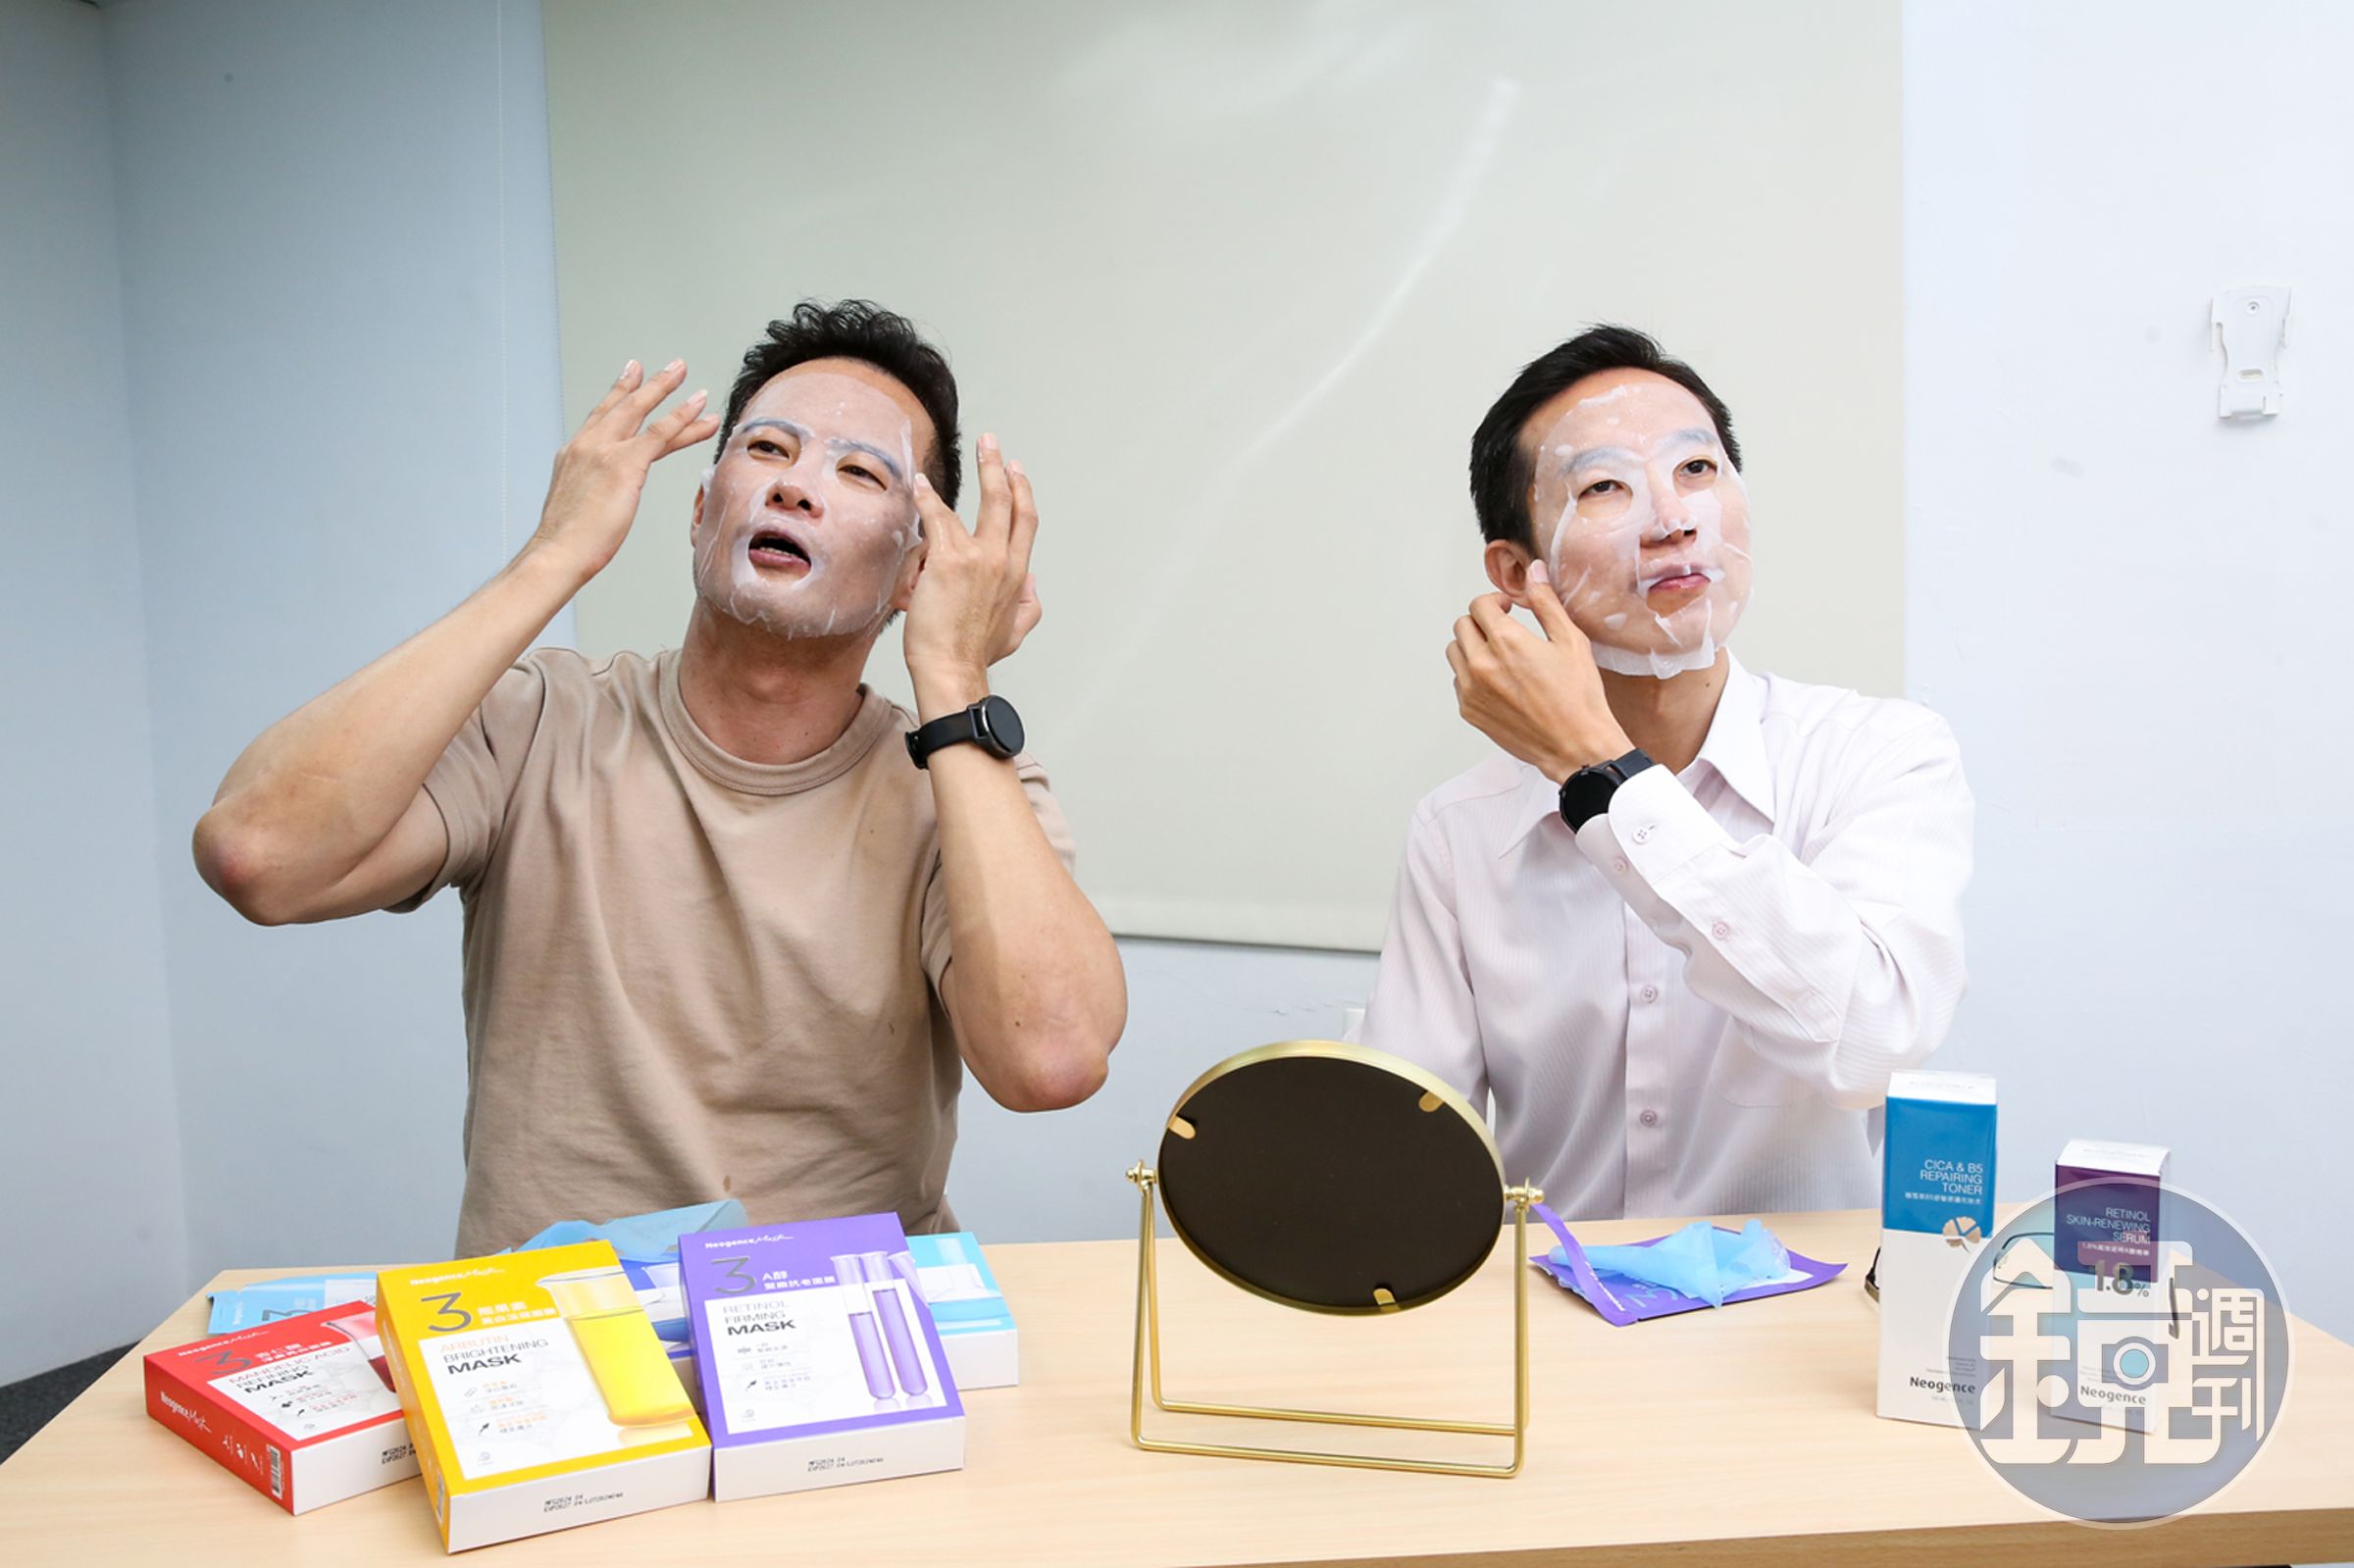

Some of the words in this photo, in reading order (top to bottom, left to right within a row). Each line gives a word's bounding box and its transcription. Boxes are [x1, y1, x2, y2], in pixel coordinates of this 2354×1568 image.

[1924, 1159, 1954, 1172] CICA
[1956, 1161, 1965, 1173] &
[1967, 1162, 1983, 1174] B5
[1919, 1169, 1983, 1185] REPAIRING
[1942, 1182, 1983, 1195] TONER
[2066, 1213, 2151, 1234] SKIN-RENEWING
[2105, 1207, 2151, 1223] RETINOL
[705, 1239, 754, 1249] Neogence
[2113, 1231, 2151, 1245] SERUM
[710, 1255, 756, 1294] 3
[421, 1291, 472, 1332] 3
[723, 1300, 790, 1314] RETINOL
[725, 1310, 786, 1324] FIRMING
[728, 1319, 796, 1336] MASK
[440, 1335, 510, 1353] ARBUTIN
[443, 1339, 549, 1363] BRIGHTENING
[194, 1350, 252, 1375] 3
[230, 1354, 311, 1384] MANDELIC
[315, 1345, 351, 1360] ACID
[447, 1353, 522, 1375] MASK
[236, 1364, 309, 1390] REFINING
[243, 1370, 314, 1393] MASK
[1910, 1376, 1976, 1393] Neogence
[2080, 1385, 2147, 1405] Neogence
